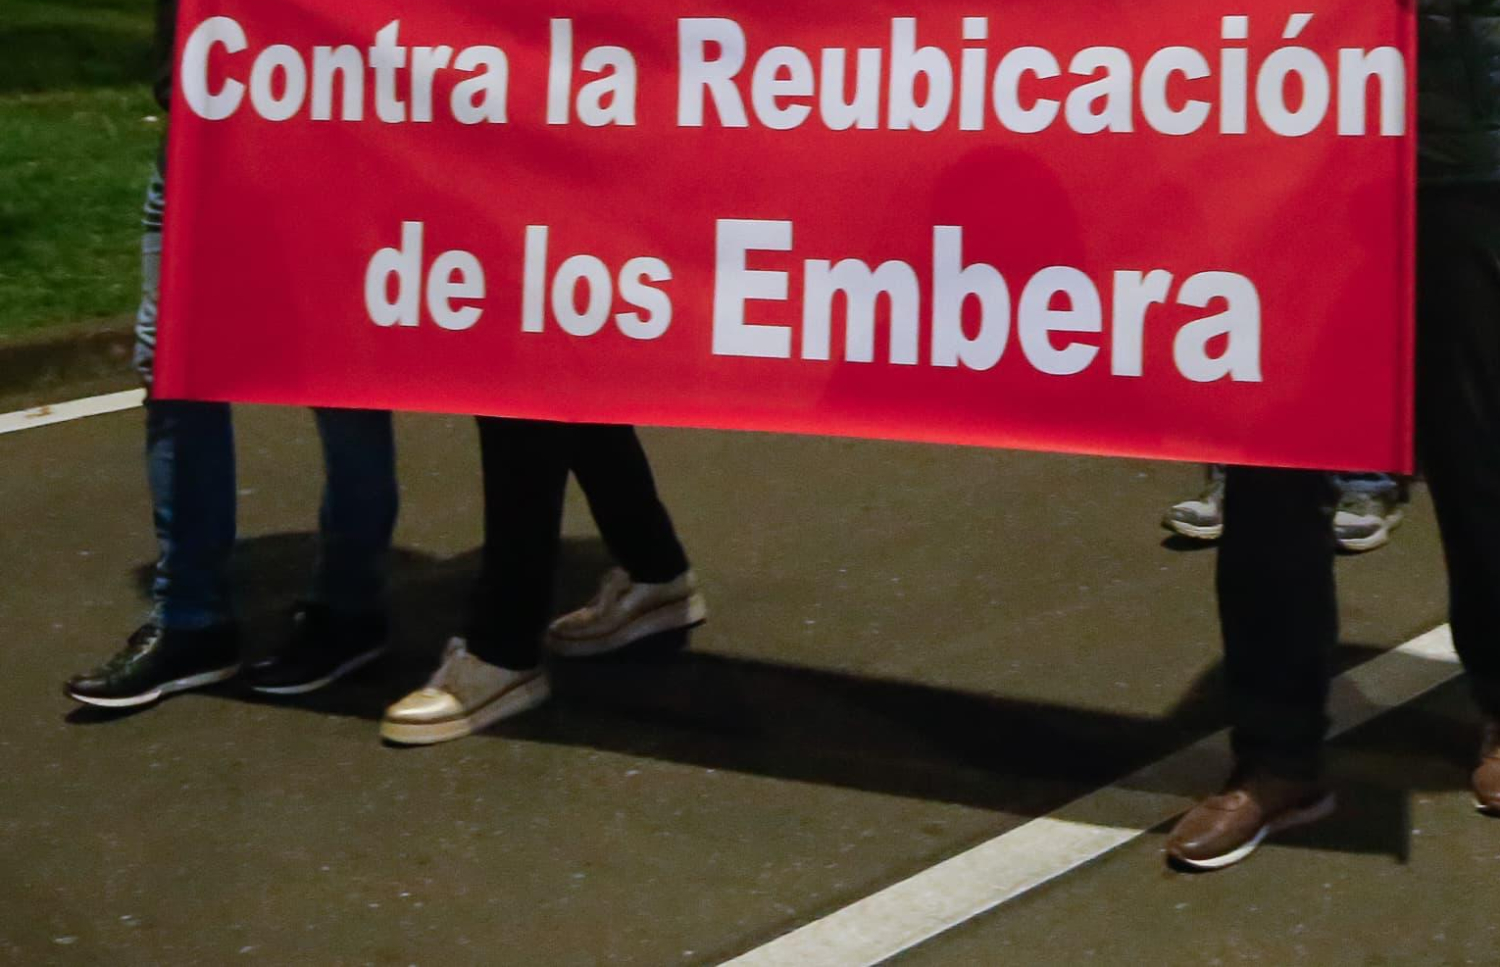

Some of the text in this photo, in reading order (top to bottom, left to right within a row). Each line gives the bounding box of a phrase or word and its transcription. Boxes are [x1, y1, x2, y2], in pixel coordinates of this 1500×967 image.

[180, 13, 1406, 137] Contra la Reubicación
[365, 218, 1263, 383] de los Embera
